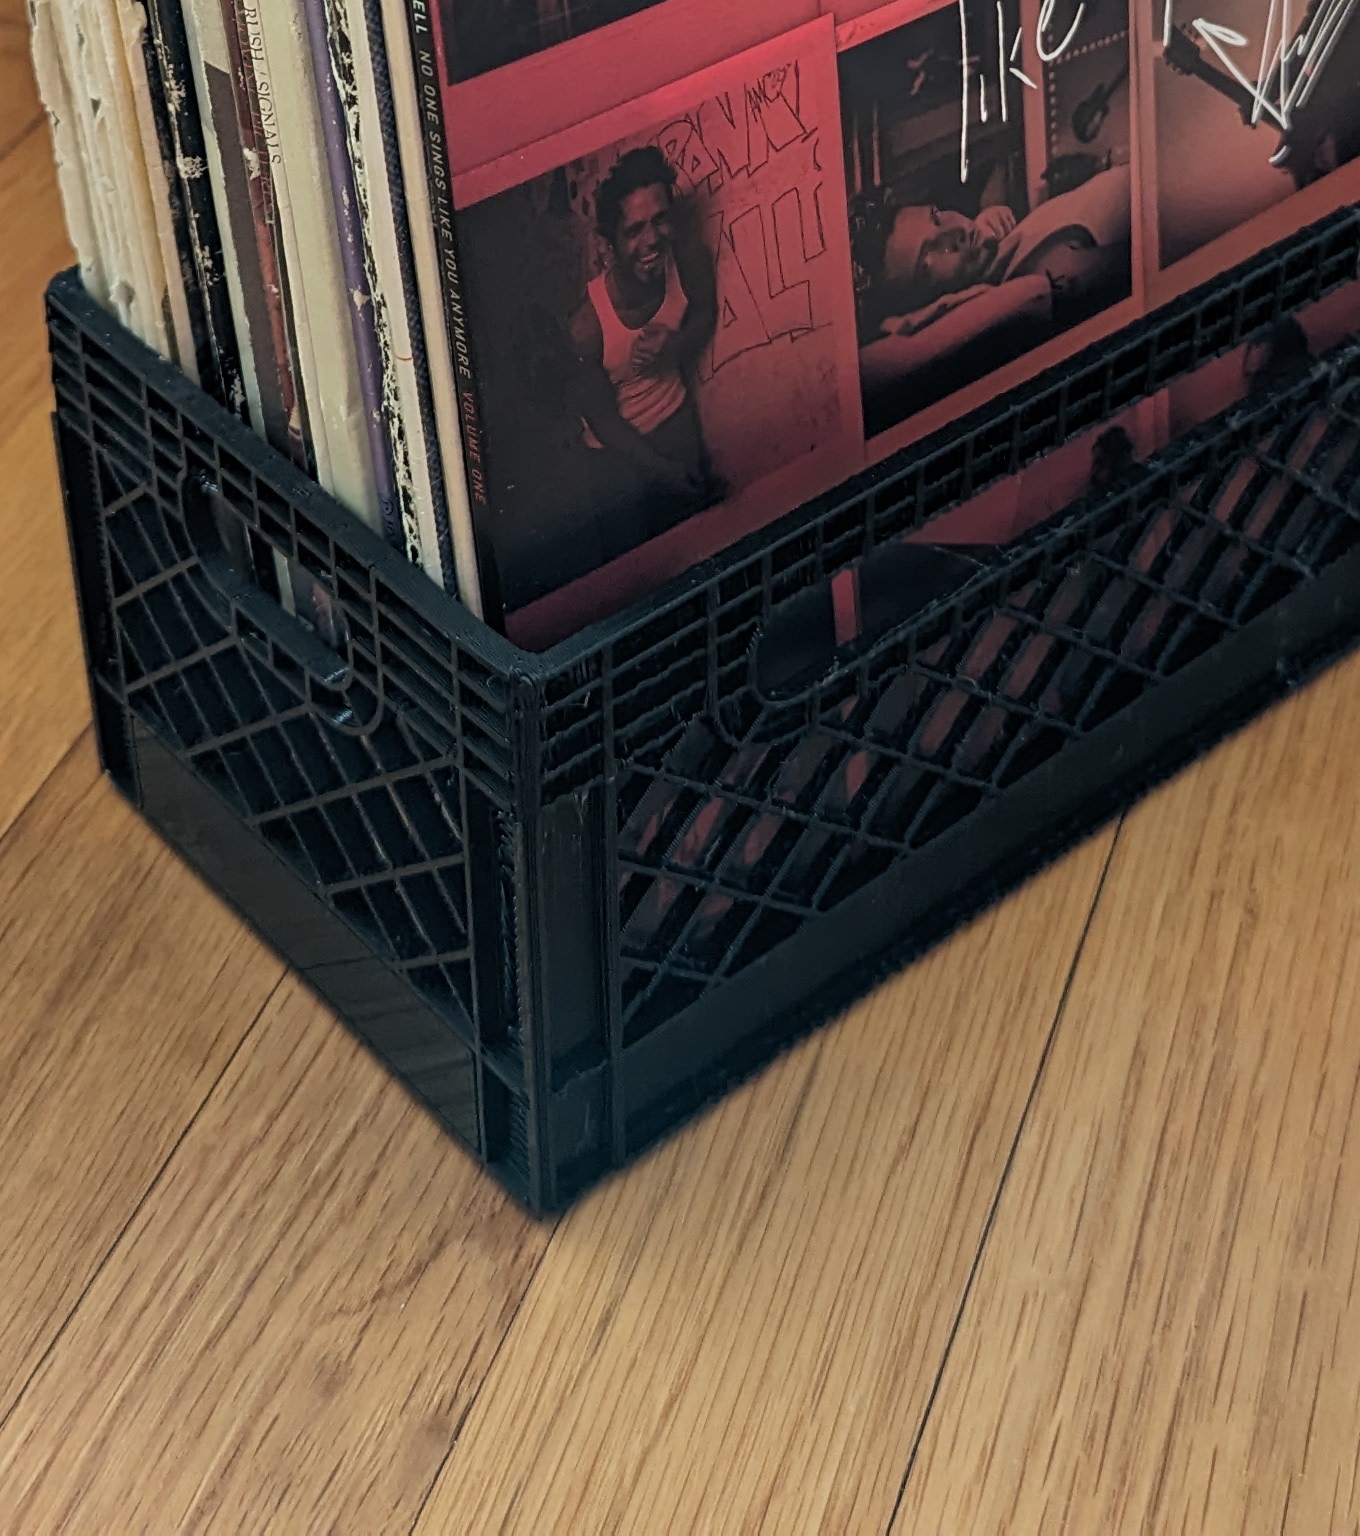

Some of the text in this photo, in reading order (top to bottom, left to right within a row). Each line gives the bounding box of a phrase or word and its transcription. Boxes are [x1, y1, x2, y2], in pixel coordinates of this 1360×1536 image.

[244, 7, 265, 61] RUSH
[257, 81, 282, 165] SIGNALS
[419, 49, 434, 76] NO
[423, 84, 439, 125] ONE
[430, 131, 447, 190] SINGS
[437, 196, 453, 244] LIKE
[440, 245, 457, 286] YOU
[449, 290, 471, 379] ANYMORE
[462, 391, 481, 464] VOLUME
[471, 467, 486, 505] ONE
